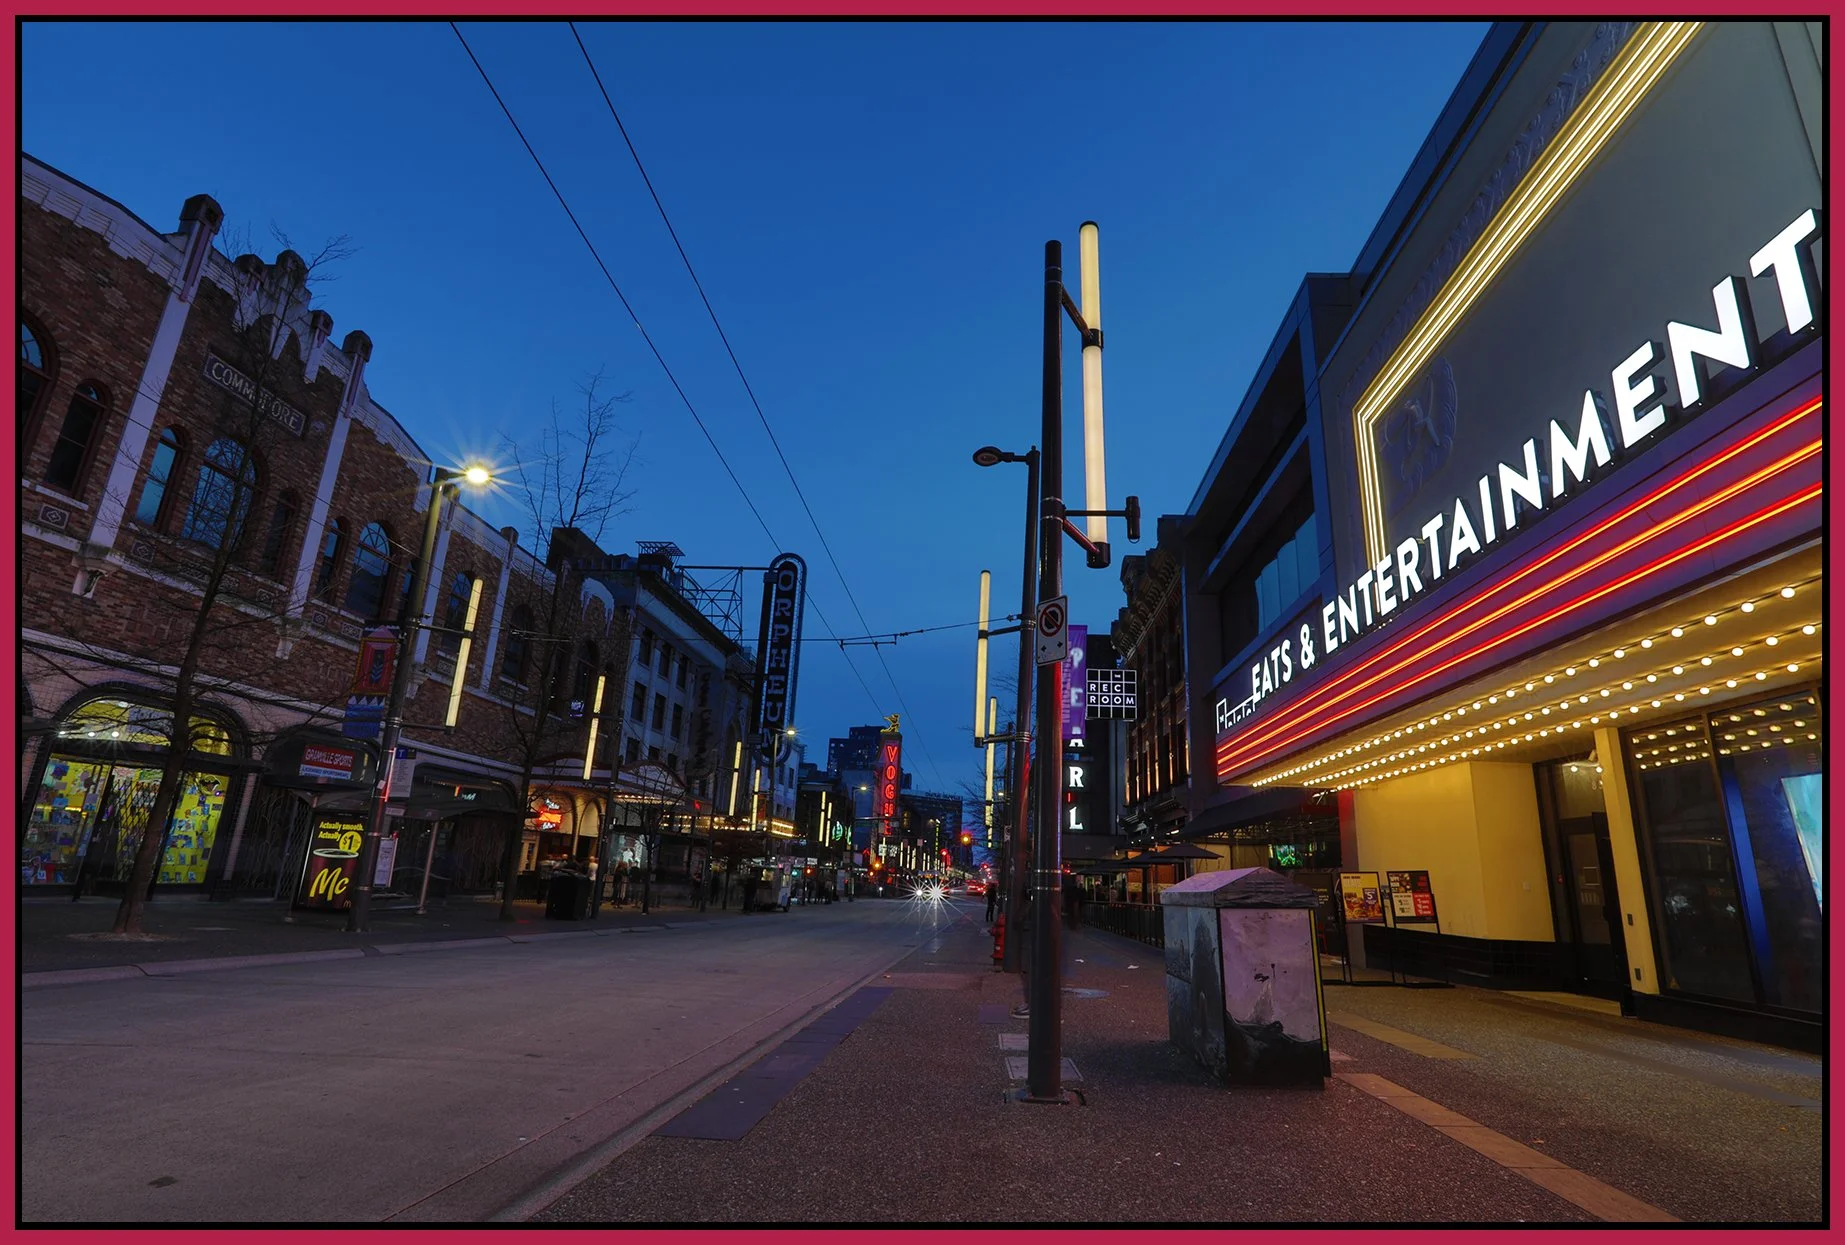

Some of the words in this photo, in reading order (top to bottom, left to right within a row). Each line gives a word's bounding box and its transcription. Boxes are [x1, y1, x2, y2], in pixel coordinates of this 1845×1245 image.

[211, 361, 300, 430] COMMDORE
[1252, 638, 1292, 702] EATS
[1299, 624, 1317, 669] &
[1322, 207, 1821, 656] ENTERTAINMENT
[761, 570, 795, 748] ORPHEUM
[1089, 683, 1122, 692] REC
[1089, 695, 1135, 705] ROOM
[1068, 647, 1085, 831] PEARL
[883, 744, 899, 837] VOGUE
[318, 831, 342, 842] Actually
[343, 834, 355, 850] $1
[319, 820, 342, 832] Actually
[342, 823, 364, 832] smooth.
[308, 866, 350, 902] Mc
